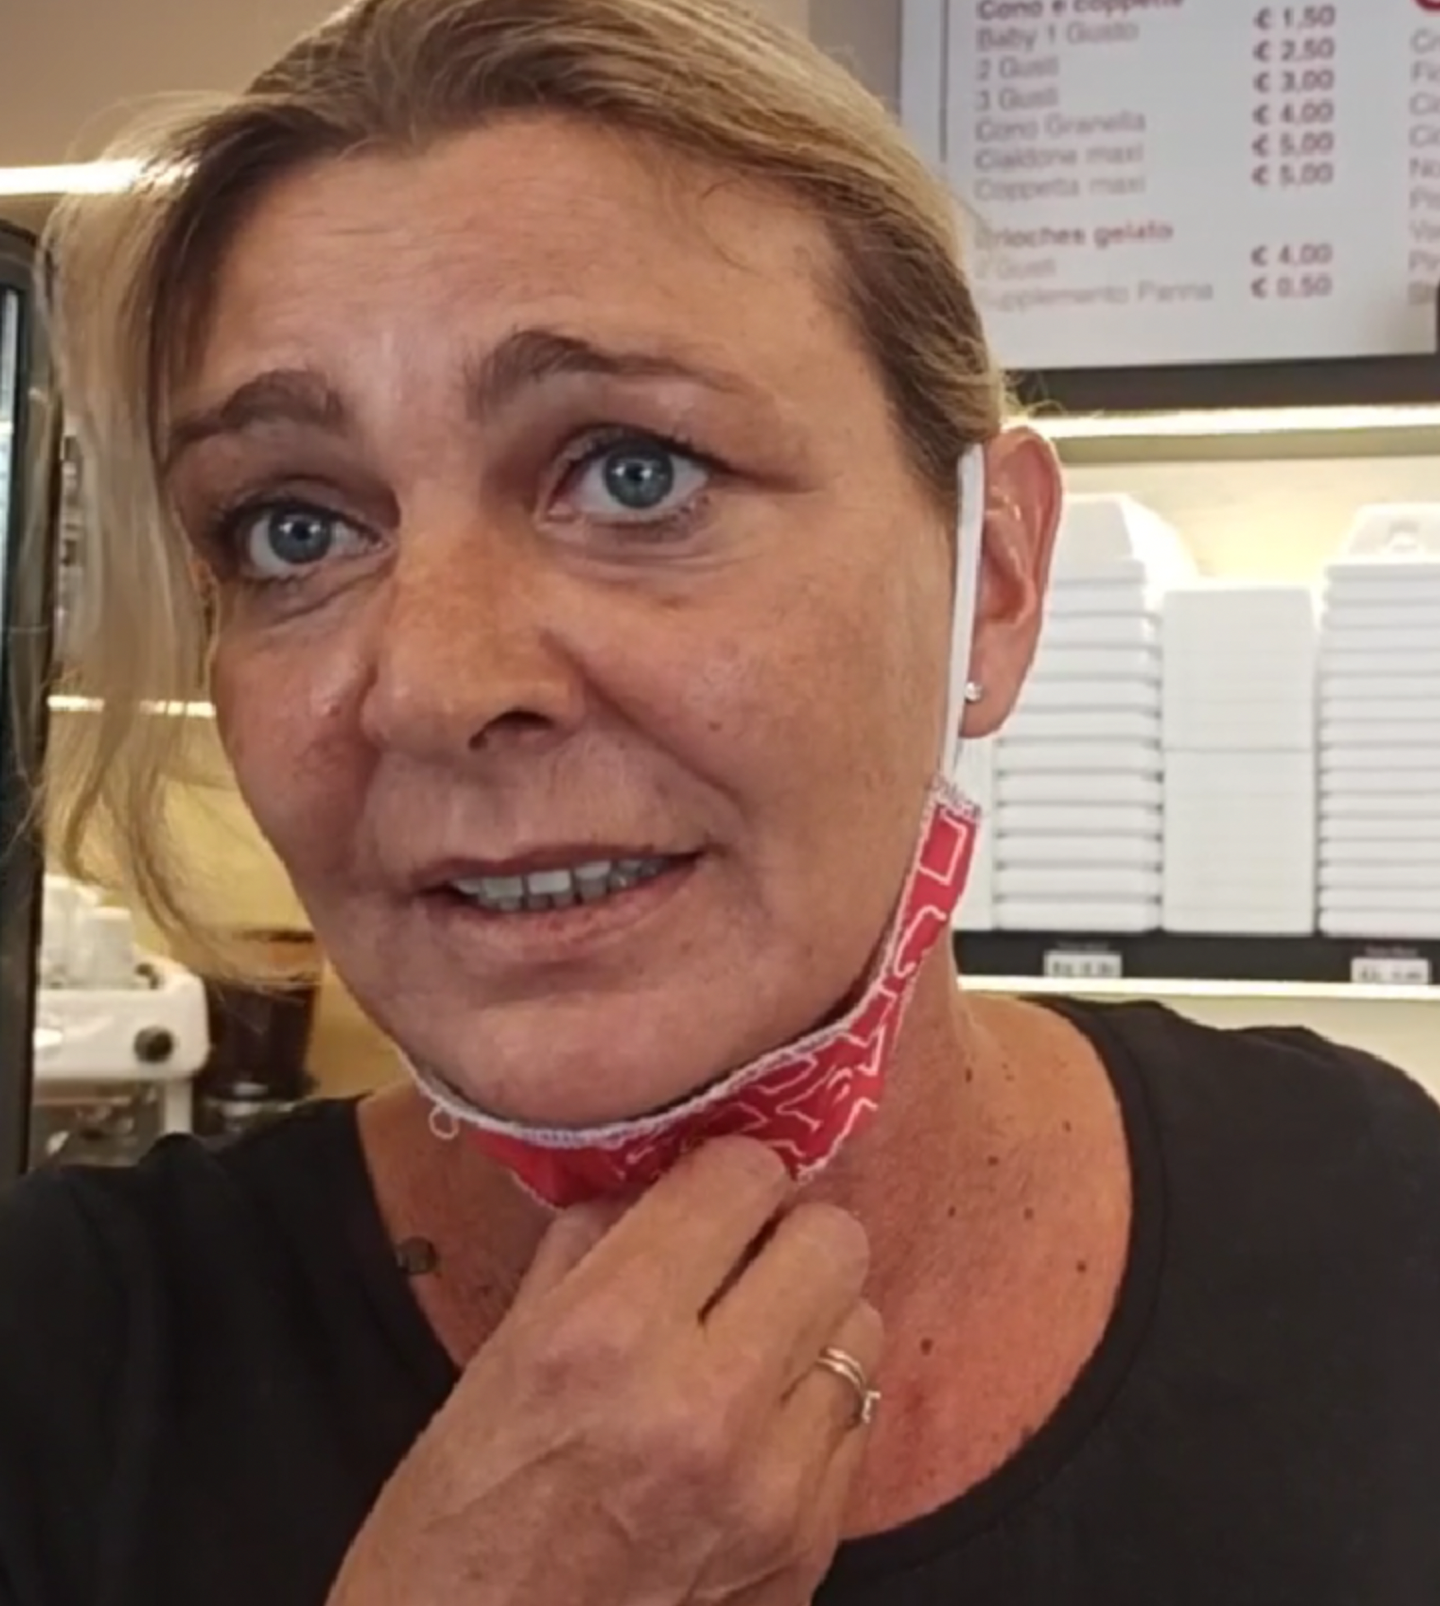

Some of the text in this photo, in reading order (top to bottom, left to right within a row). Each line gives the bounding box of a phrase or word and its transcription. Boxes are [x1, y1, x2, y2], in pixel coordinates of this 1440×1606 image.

[976, 0, 1043, 20] Cono
[1253, 4, 1336, 30] € 1,50
[977, 27, 1037, 52] Baby
[1066, 21, 1140, 45] Gusto
[1253, 36, 1335, 63] € 2,50
[976, 56, 1059, 81] 2 Gusti
[1253, 68, 1335, 94] € 3,00
[975, 87, 1058, 112] 3 Gusti
[975, 110, 1146, 142] Cono Granella
[1252, 101, 1335, 127] € 4,00
[1251, 131, 1335, 158] € 5,00
[974, 148, 1077, 173] Cialdone
[1251, 162, 1334, 187] € 5,00
[974, 177, 1080, 203] Coppetta
[1094, 220, 1174, 249] gelato
[1250, 243, 1334, 268] € 4,00
[1250, 273, 1334, 299] € 0,50
